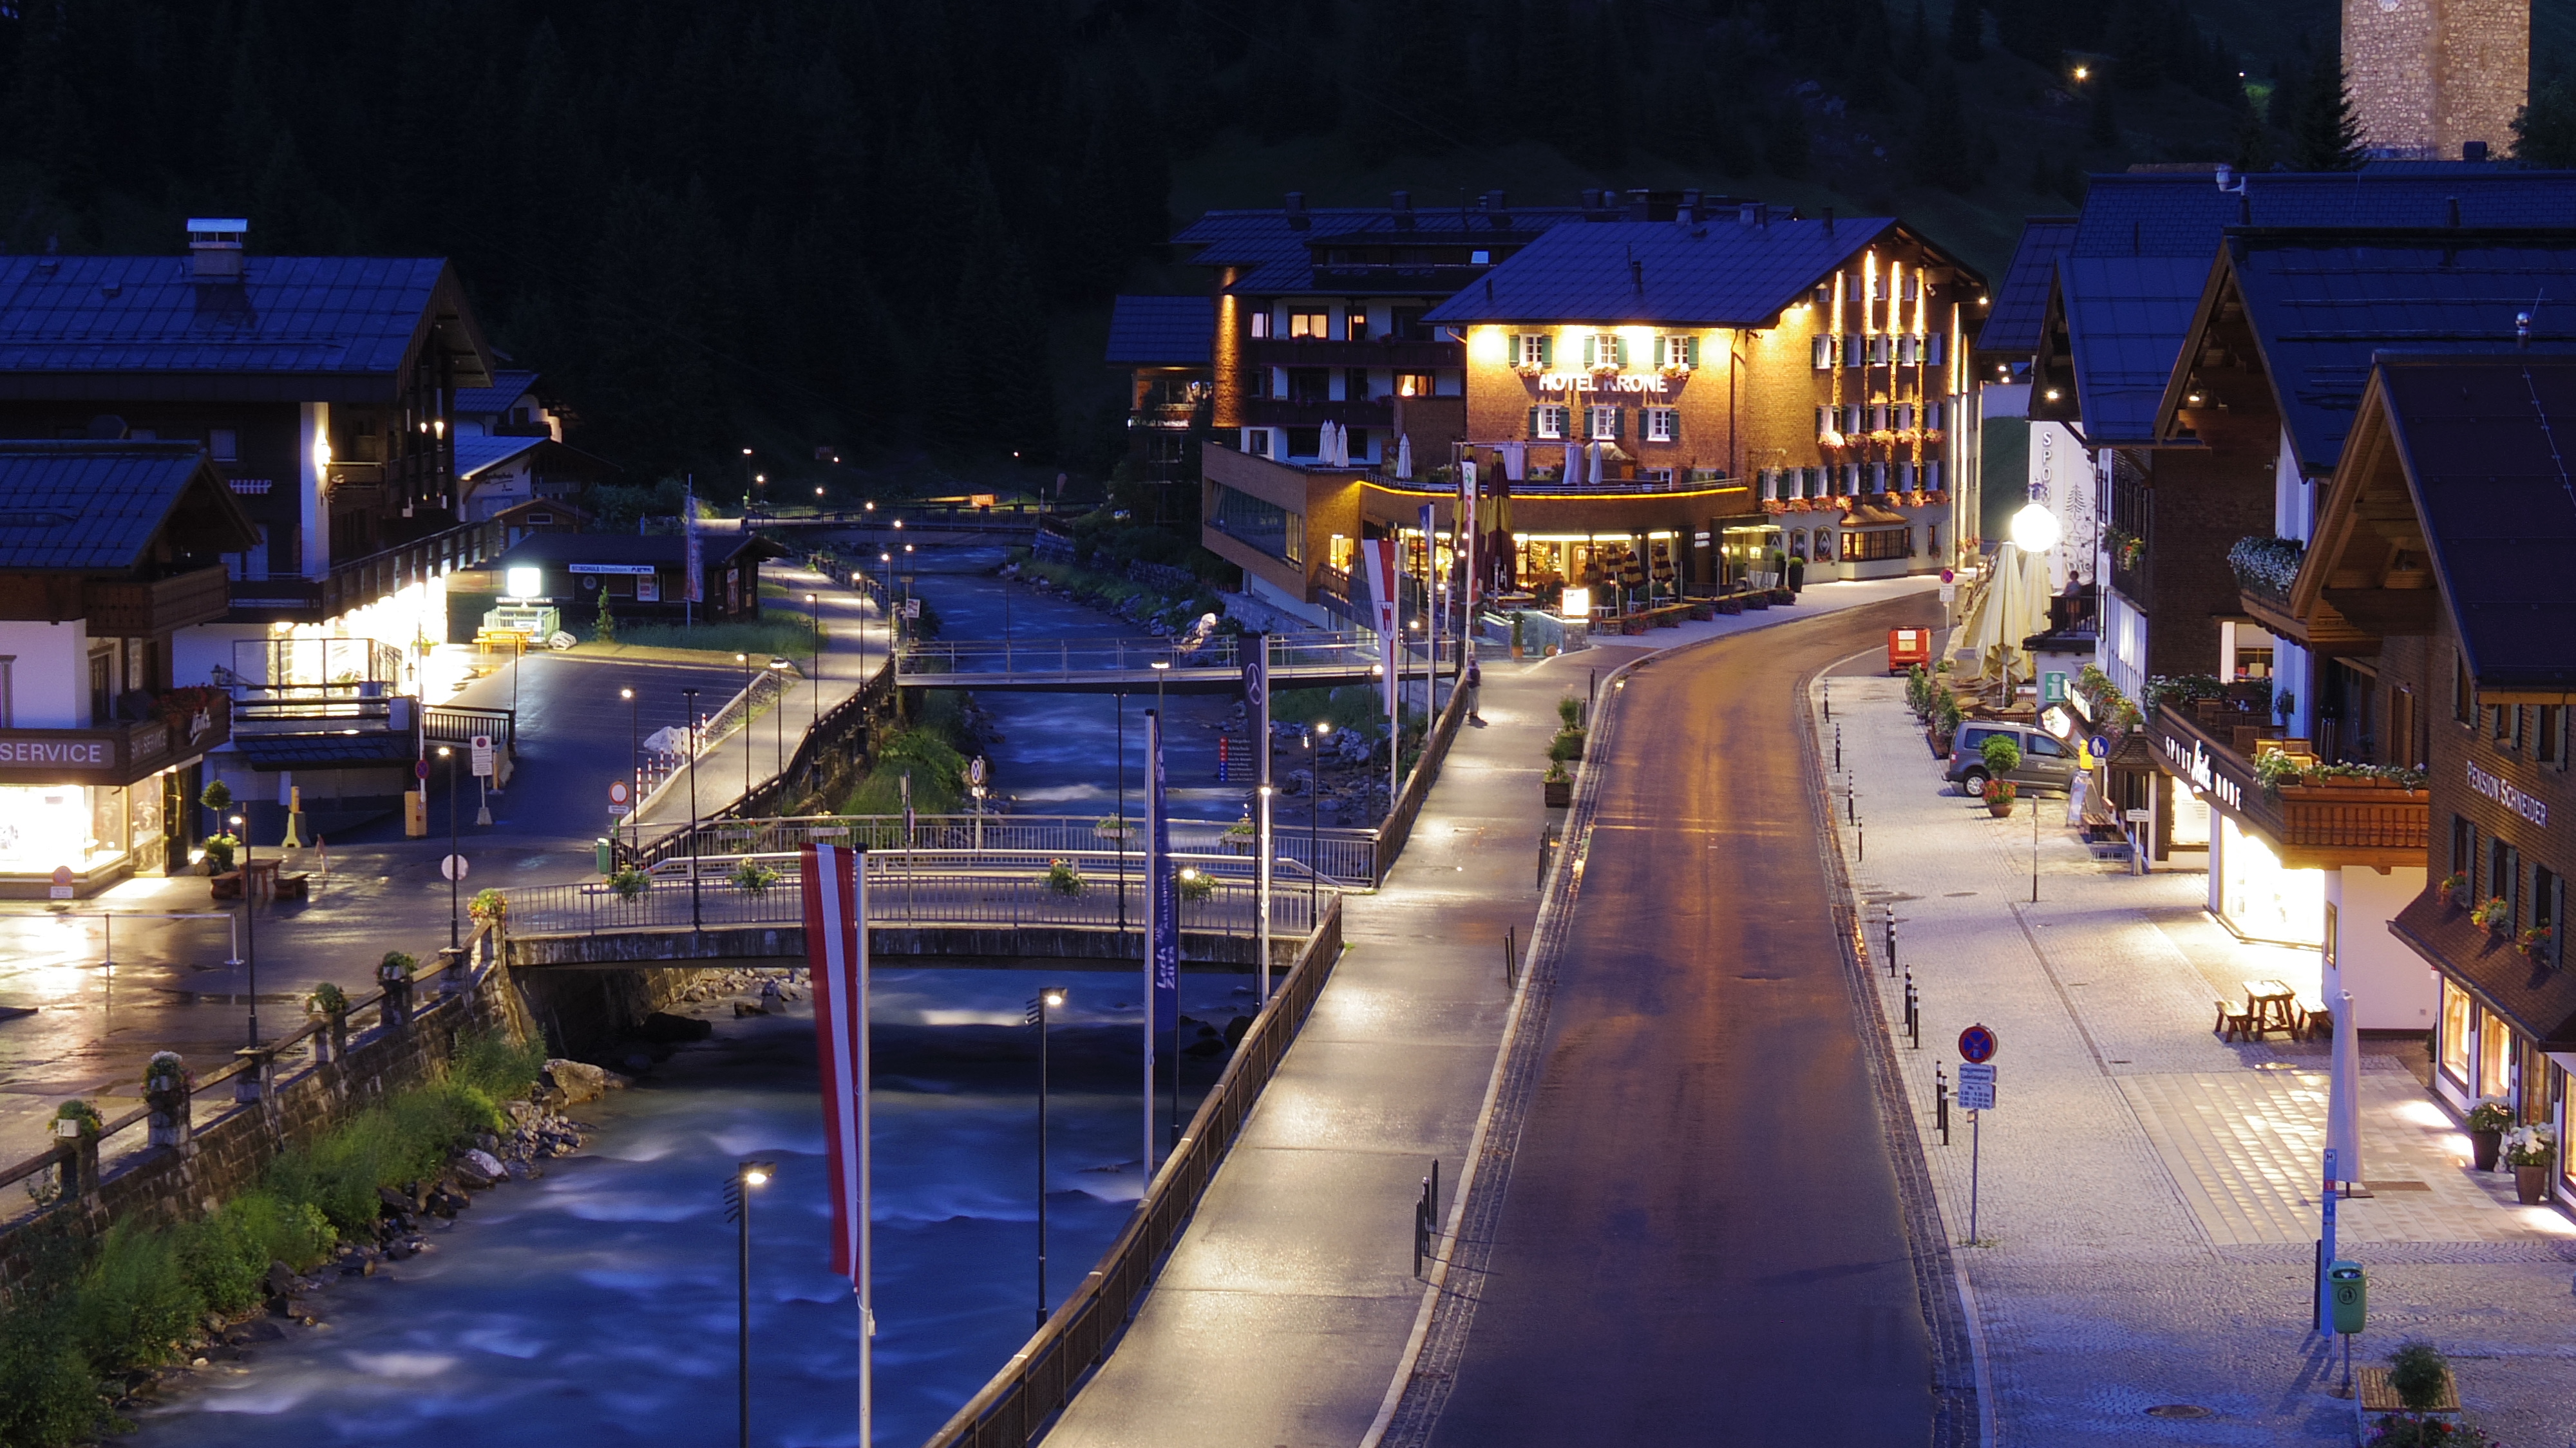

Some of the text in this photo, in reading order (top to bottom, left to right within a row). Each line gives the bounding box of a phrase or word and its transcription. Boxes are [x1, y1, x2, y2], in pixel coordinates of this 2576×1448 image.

[1539, 372, 1669, 393] HOTEL KRONE
[0, 743, 102, 763] SERVICE
[2165, 736, 2192, 774] SPORT
[2467, 760, 2547, 828] PENSION SCHNEIDER
[1157, 947, 1167, 989] Lech
